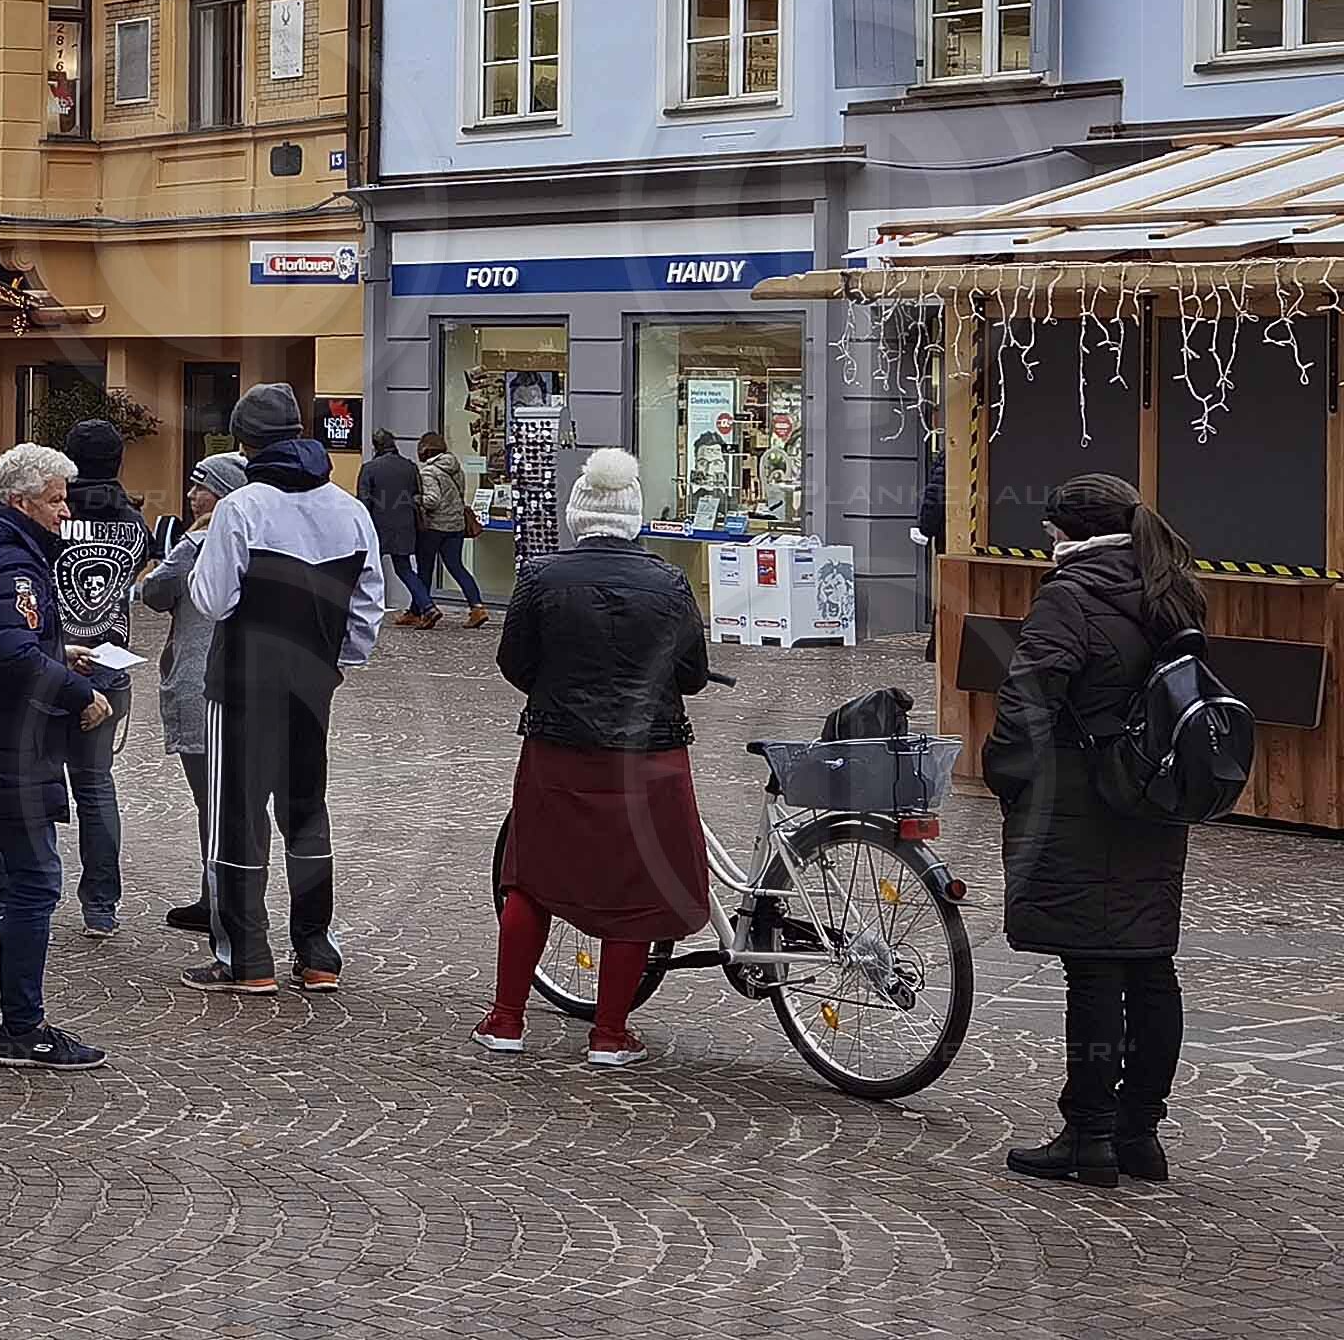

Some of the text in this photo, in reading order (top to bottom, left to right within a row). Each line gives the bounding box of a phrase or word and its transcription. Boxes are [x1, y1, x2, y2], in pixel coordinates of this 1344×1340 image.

[330, 153, 343, 167] 13
[465, 266, 520, 288] FOTO
[666, 259, 747, 284] HANDY
[327, 427, 351, 439] hair
[60, 519, 137, 542] VOLBEAT
[62, 547, 108, 568] BEYOND
